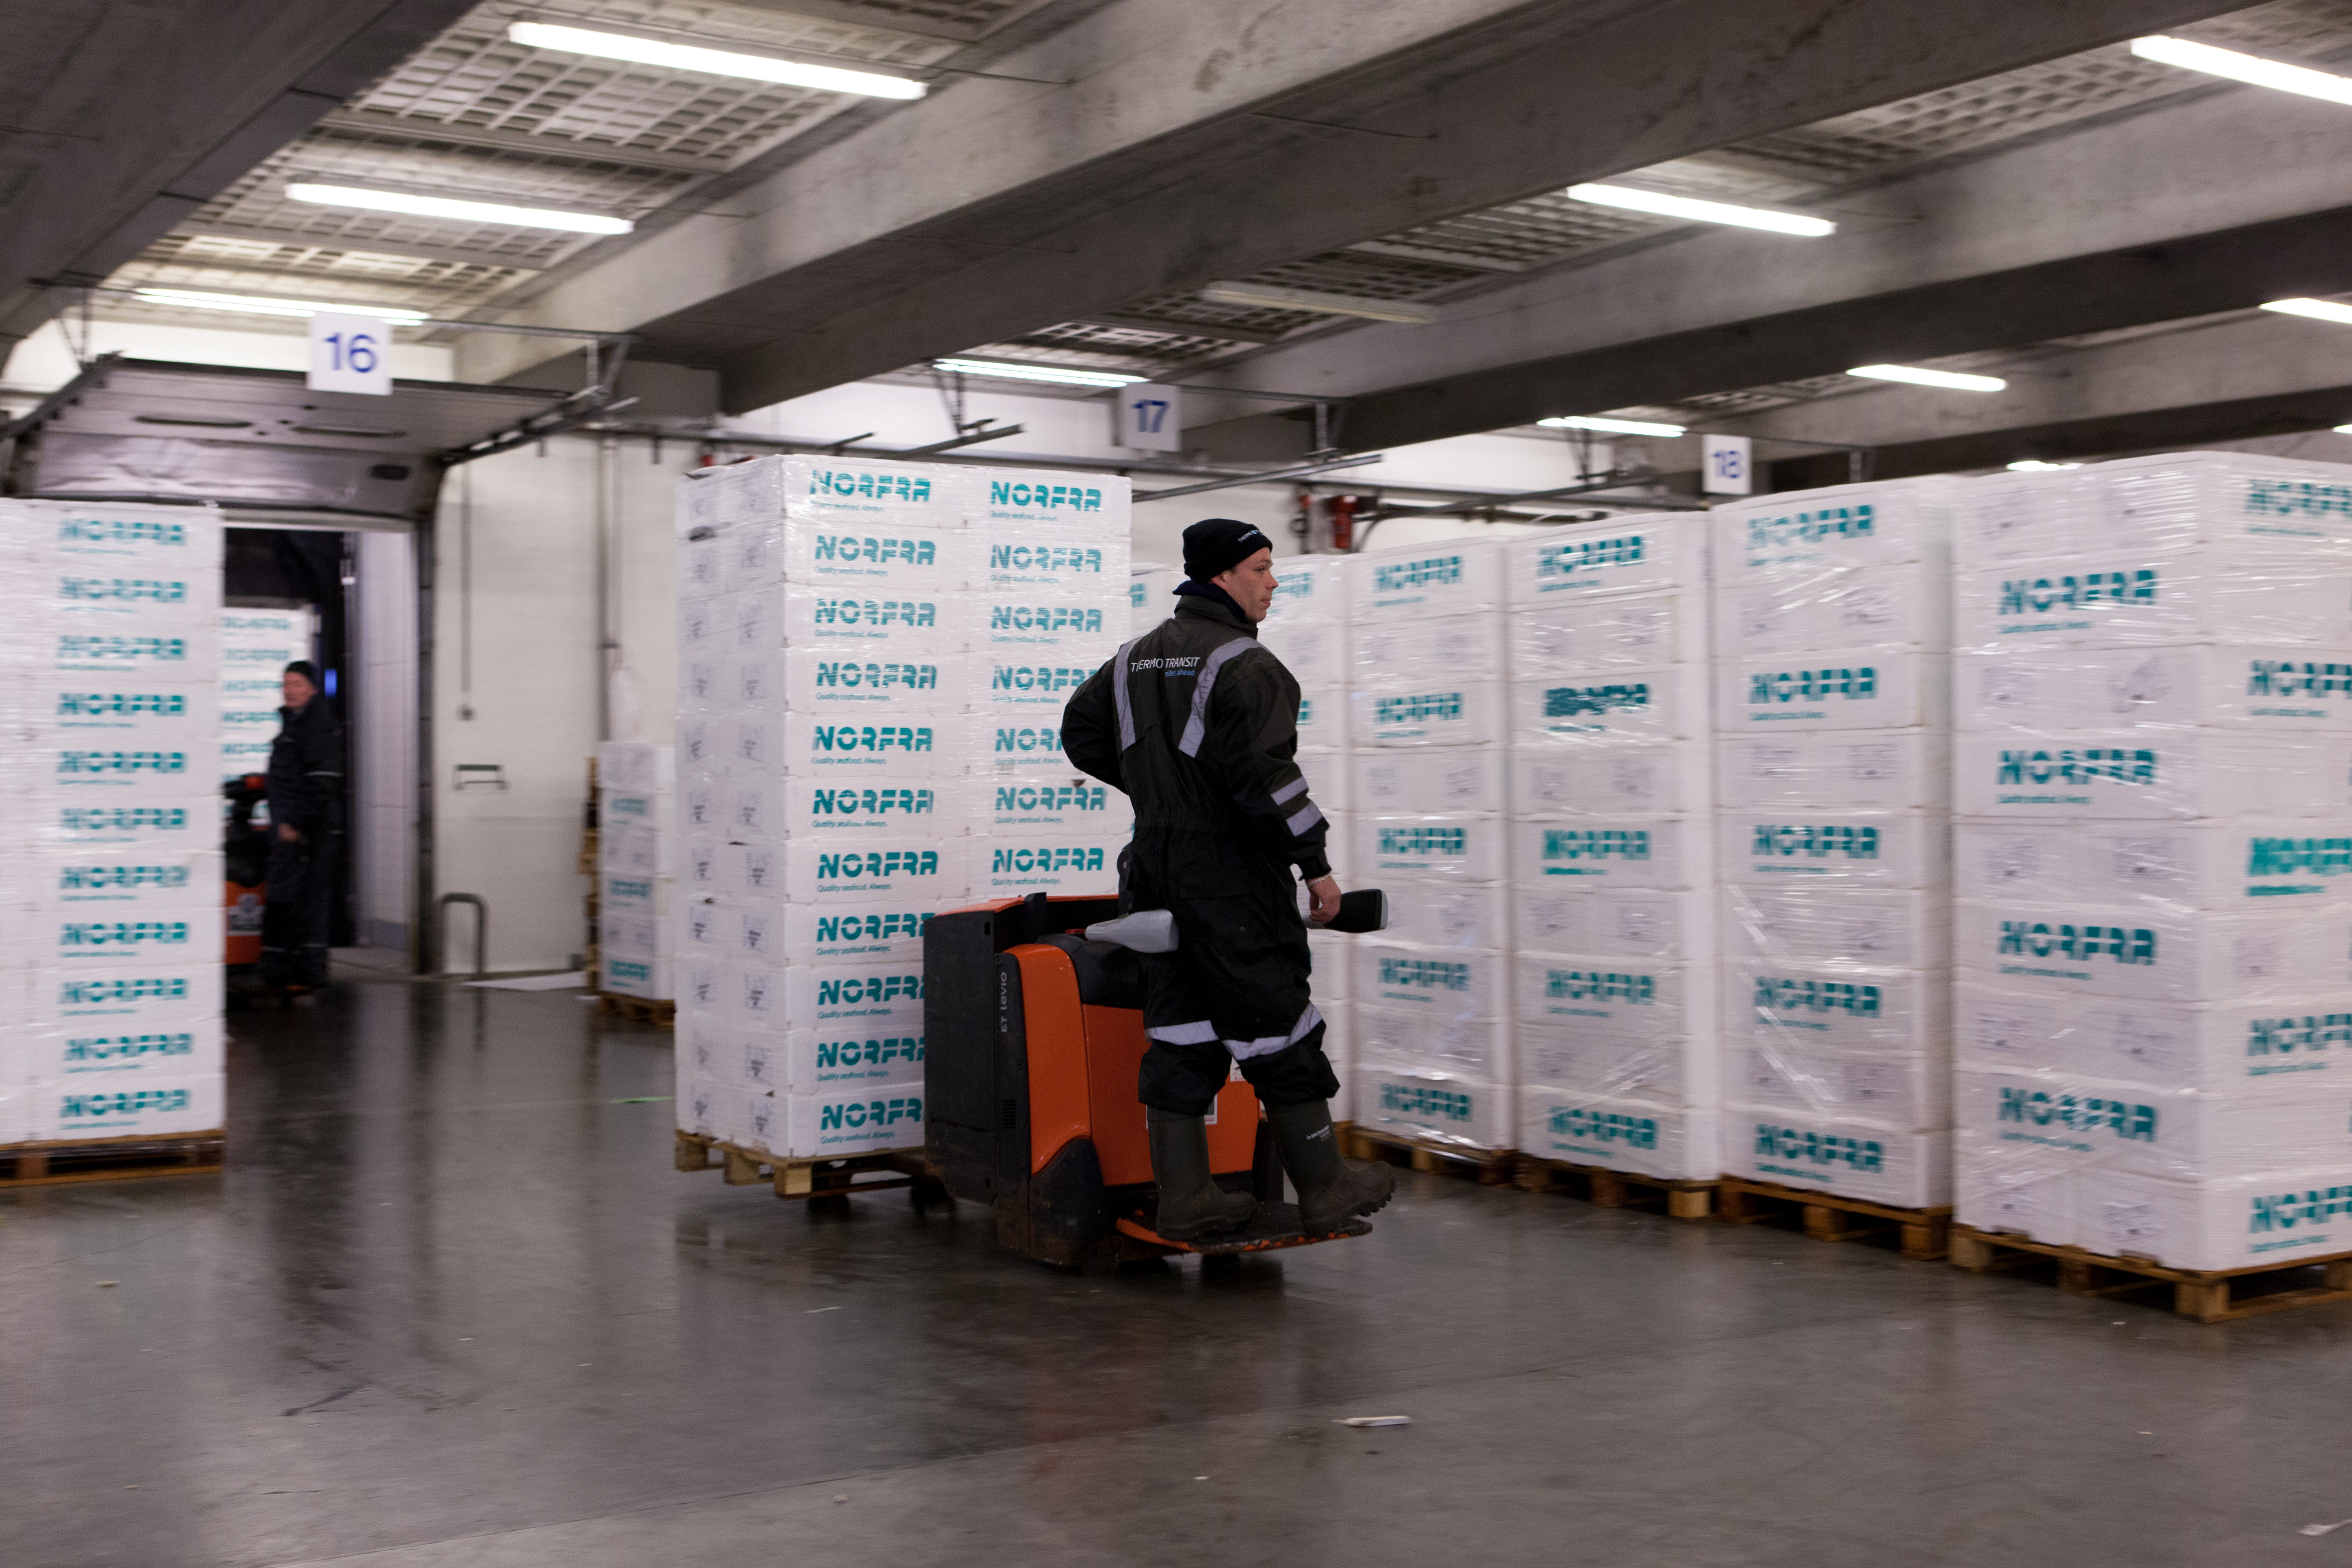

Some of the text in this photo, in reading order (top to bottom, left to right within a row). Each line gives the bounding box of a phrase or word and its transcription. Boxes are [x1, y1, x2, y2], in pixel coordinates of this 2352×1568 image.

[322, 332, 378, 373] 16
[1132, 400, 1171, 433] 17
[1712, 450, 1743, 478] 18
[810, 470, 931, 502] NORFRA
[991, 481, 1101, 512] NORFRA
[815, 535, 936, 565] NORFRA
[990, 545, 1101, 572] NORFRA
[815, 599, 935, 626] NORFRA
[991, 606, 1101, 632] NORFRA
[817, 662, 937, 689] NORFRA
[993, 666, 1099, 691] NORFR
[1131, 657, 1201, 672] THERMO TRANSIT
[2249, 660, 2352, 699] NORF
[813, 726, 932, 751] NORFRA
[995, 728, 1063, 752] NOR
[812, 789, 934, 814] NORFRA
[995, 787, 1106, 810] NORFRA
[818, 851, 938, 879] NORFRA
[992, 848, 1104, 873] NORFRA
[818, 976, 924, 1006] NORFR
[2249, 1014, 2352, 1055] NORF
[817, 1037, 924, 1068] NORFR
[821, 1098, 923, 1130] NORFR
[2251, 1186, 2352, 1233] NORF
